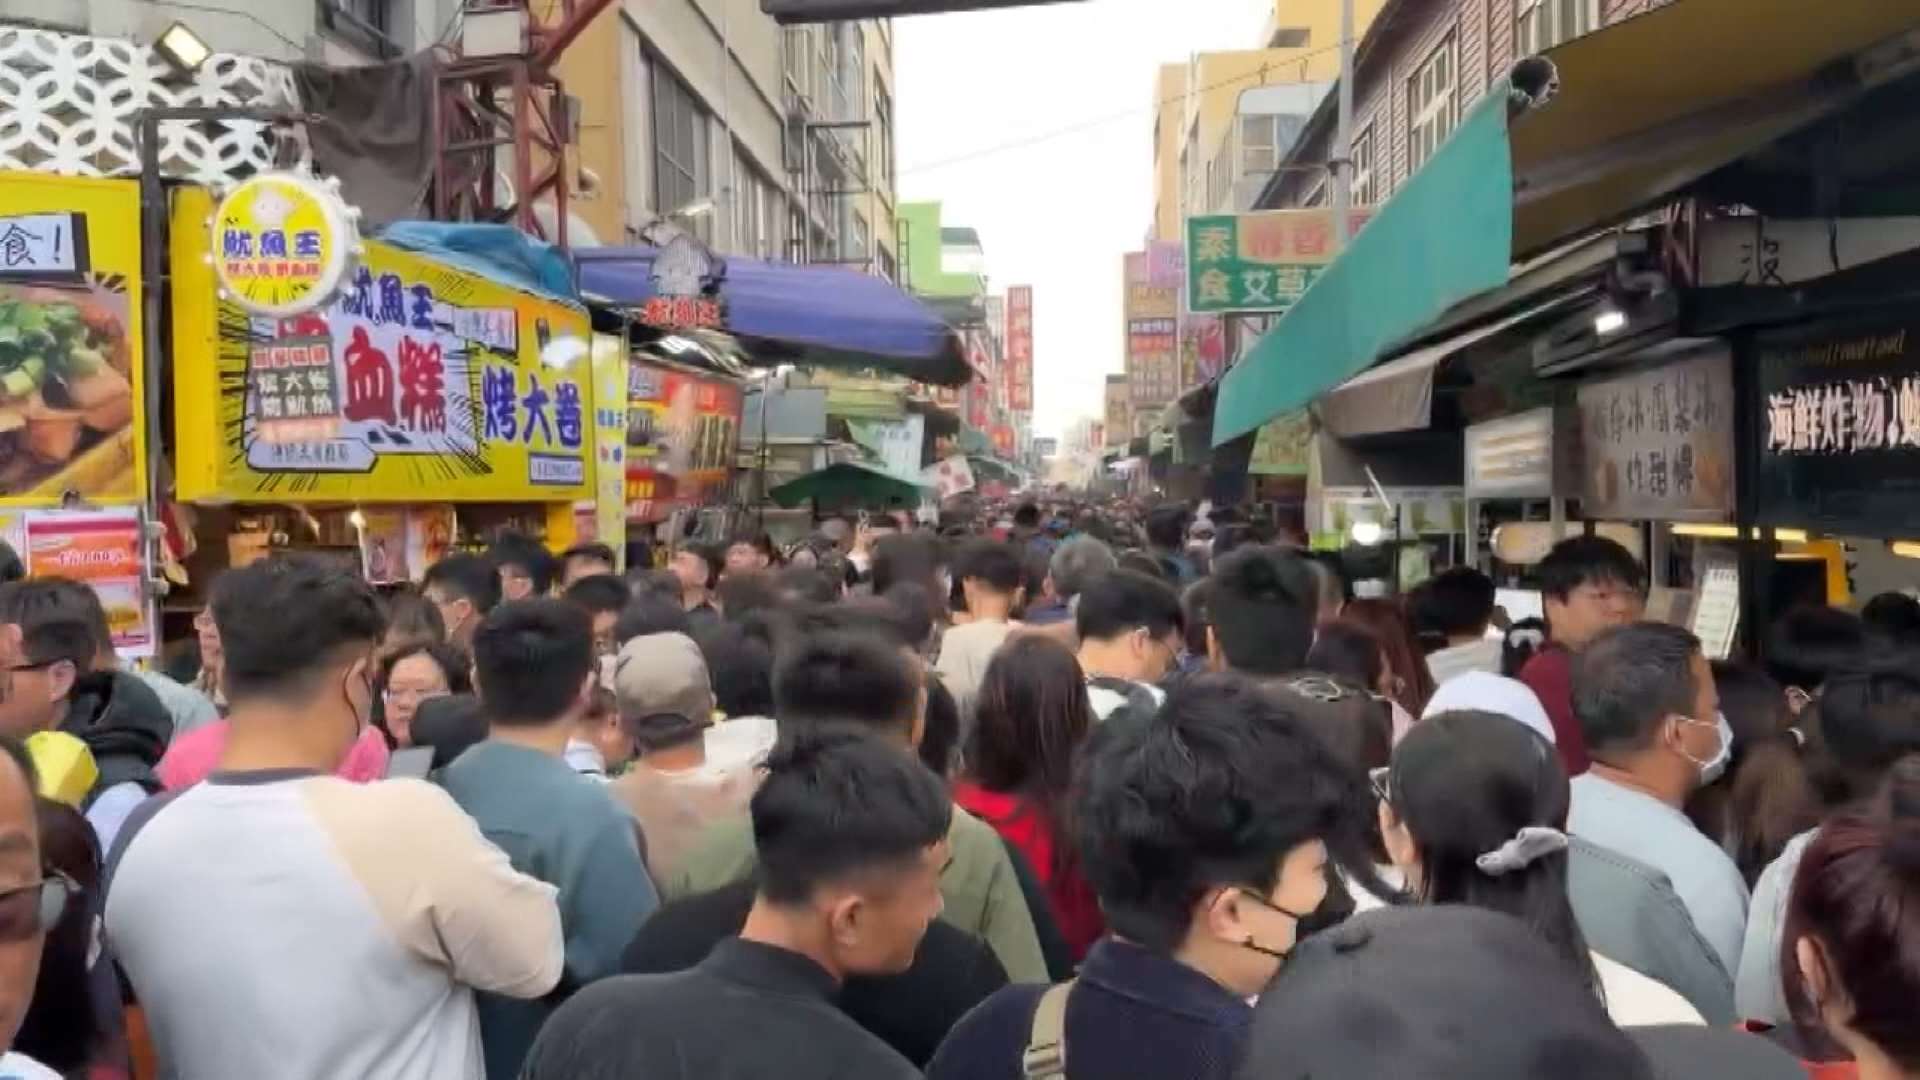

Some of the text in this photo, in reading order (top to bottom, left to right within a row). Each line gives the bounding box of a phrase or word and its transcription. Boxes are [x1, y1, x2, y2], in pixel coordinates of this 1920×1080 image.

[223, 229, 321, 256] 魷魚王
[342, 266, 434, 331] 魷魚王
[1767, 382, 1885, 456] 海鮮炸物
